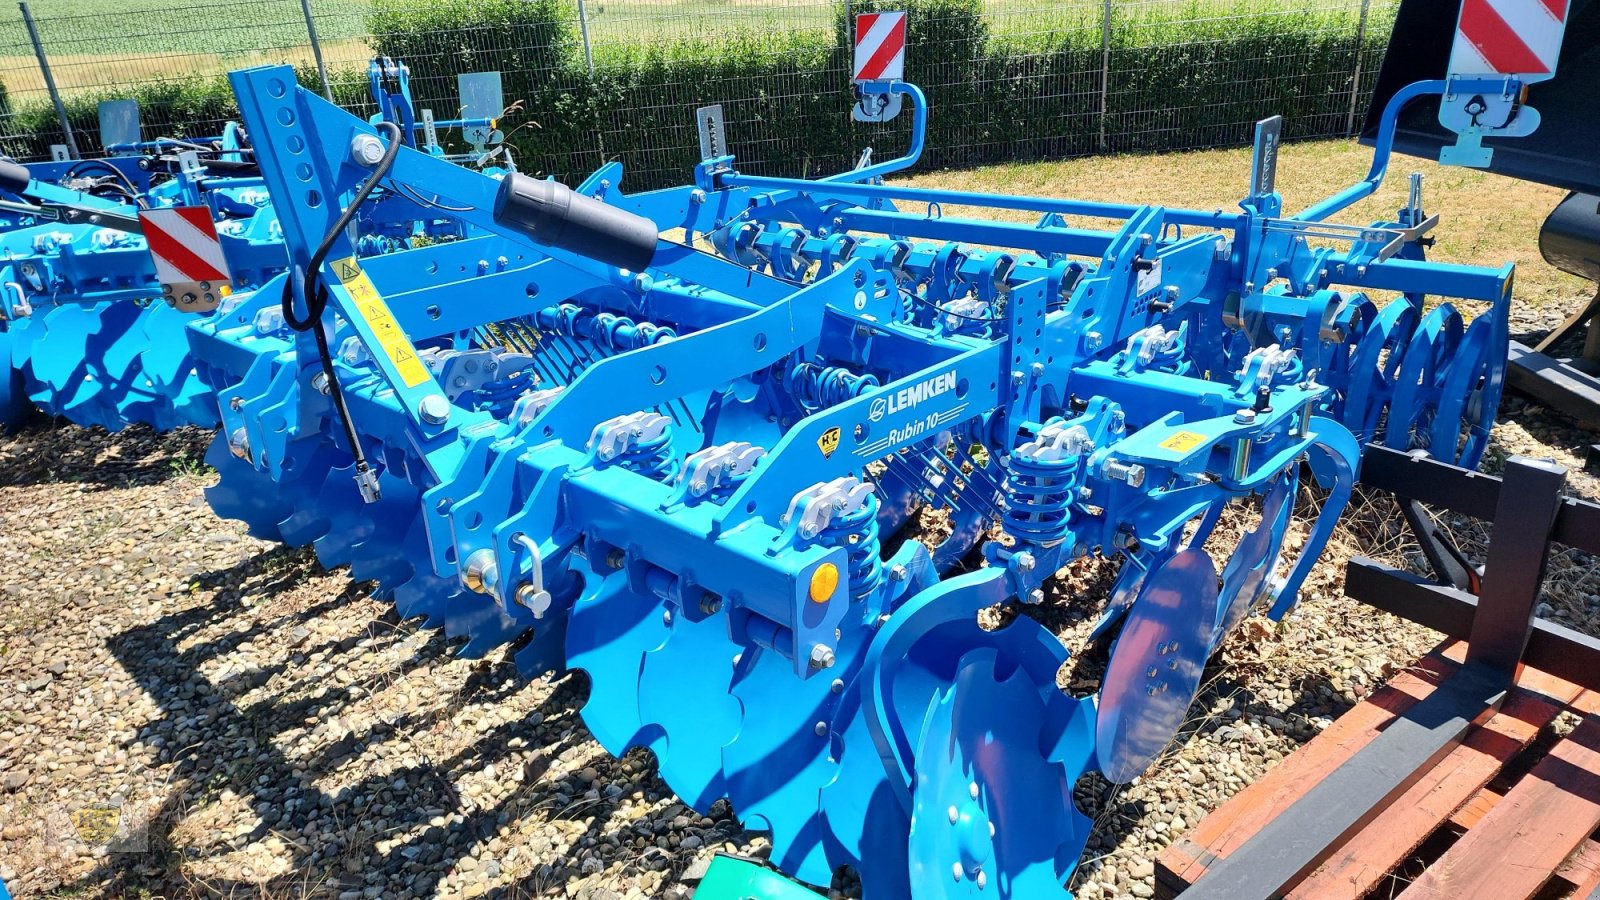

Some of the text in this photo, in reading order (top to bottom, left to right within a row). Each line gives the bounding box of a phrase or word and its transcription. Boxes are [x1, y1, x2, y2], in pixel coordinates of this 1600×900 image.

[888, 370, 957, 415] LEMKEN
[887, 412, 939, 447] Rubin 10
